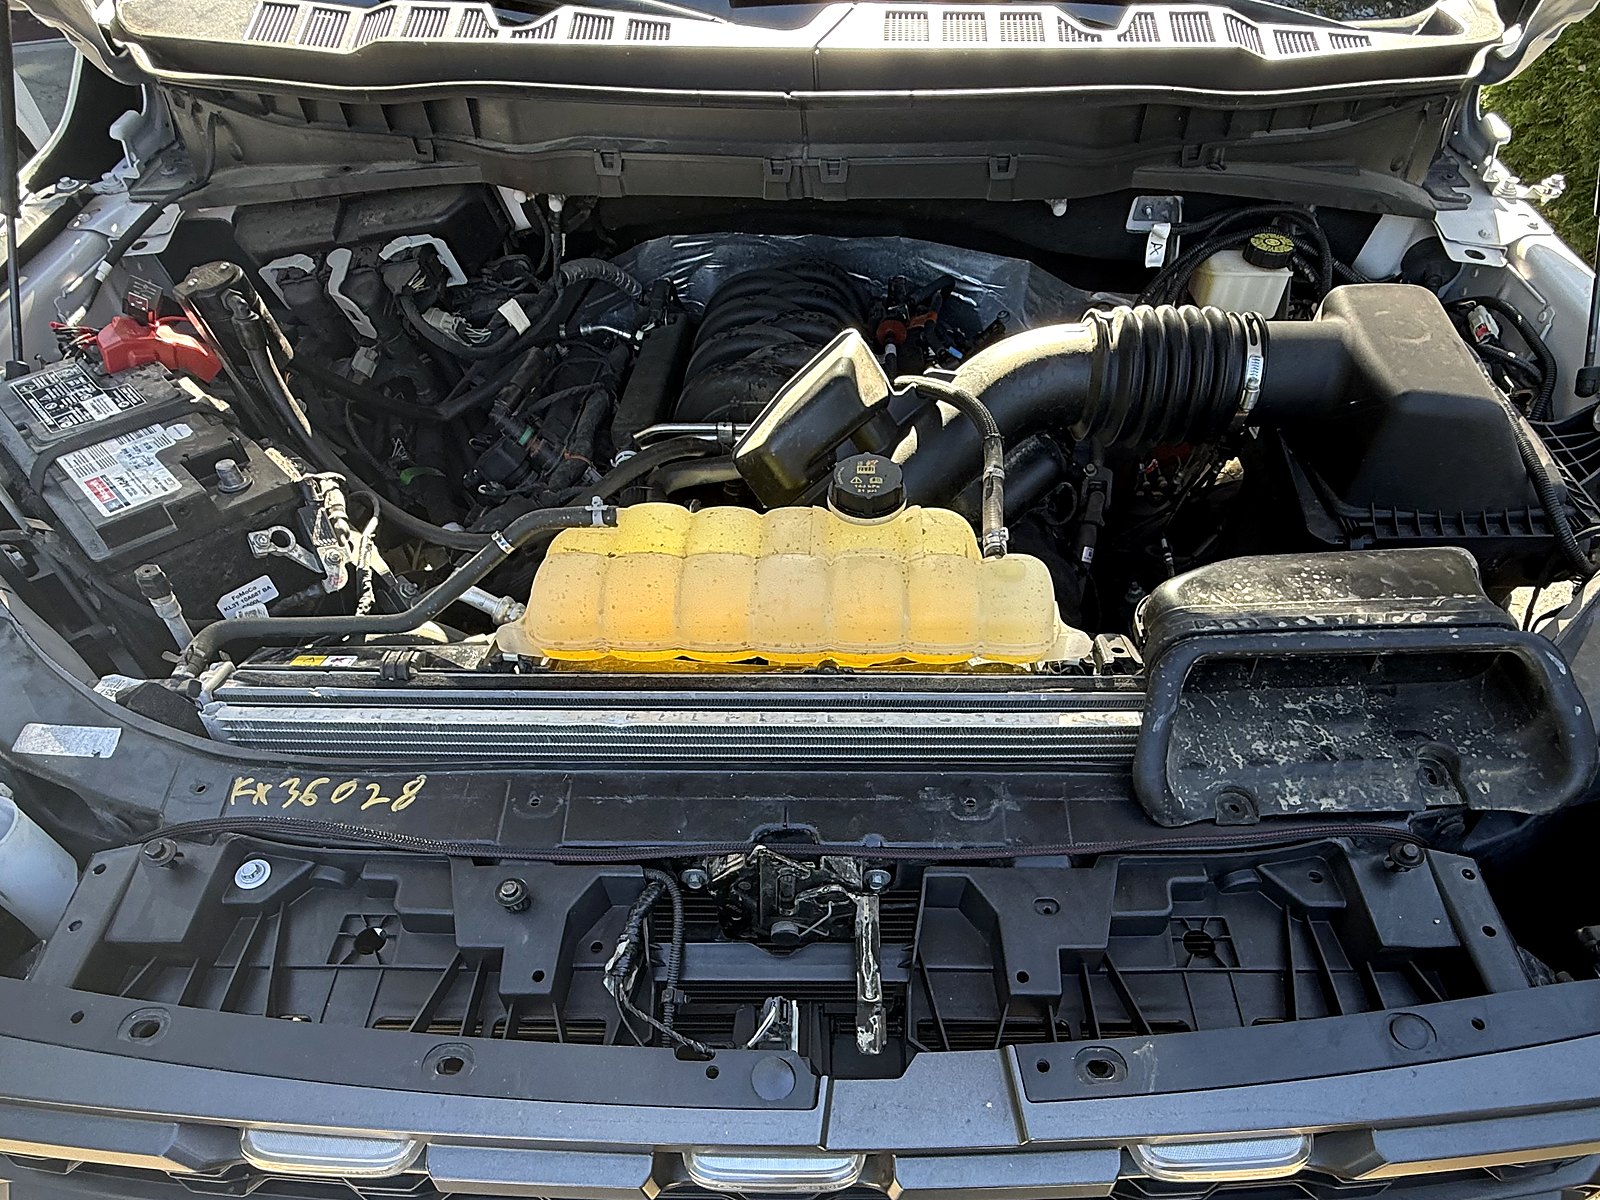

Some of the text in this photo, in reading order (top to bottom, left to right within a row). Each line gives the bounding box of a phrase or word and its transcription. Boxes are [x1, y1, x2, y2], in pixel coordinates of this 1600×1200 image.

[223, 602, 240, 612] KL3T
[262, 585, 272, 593] BA
[231, 586, 257, 601] FoMoCo
